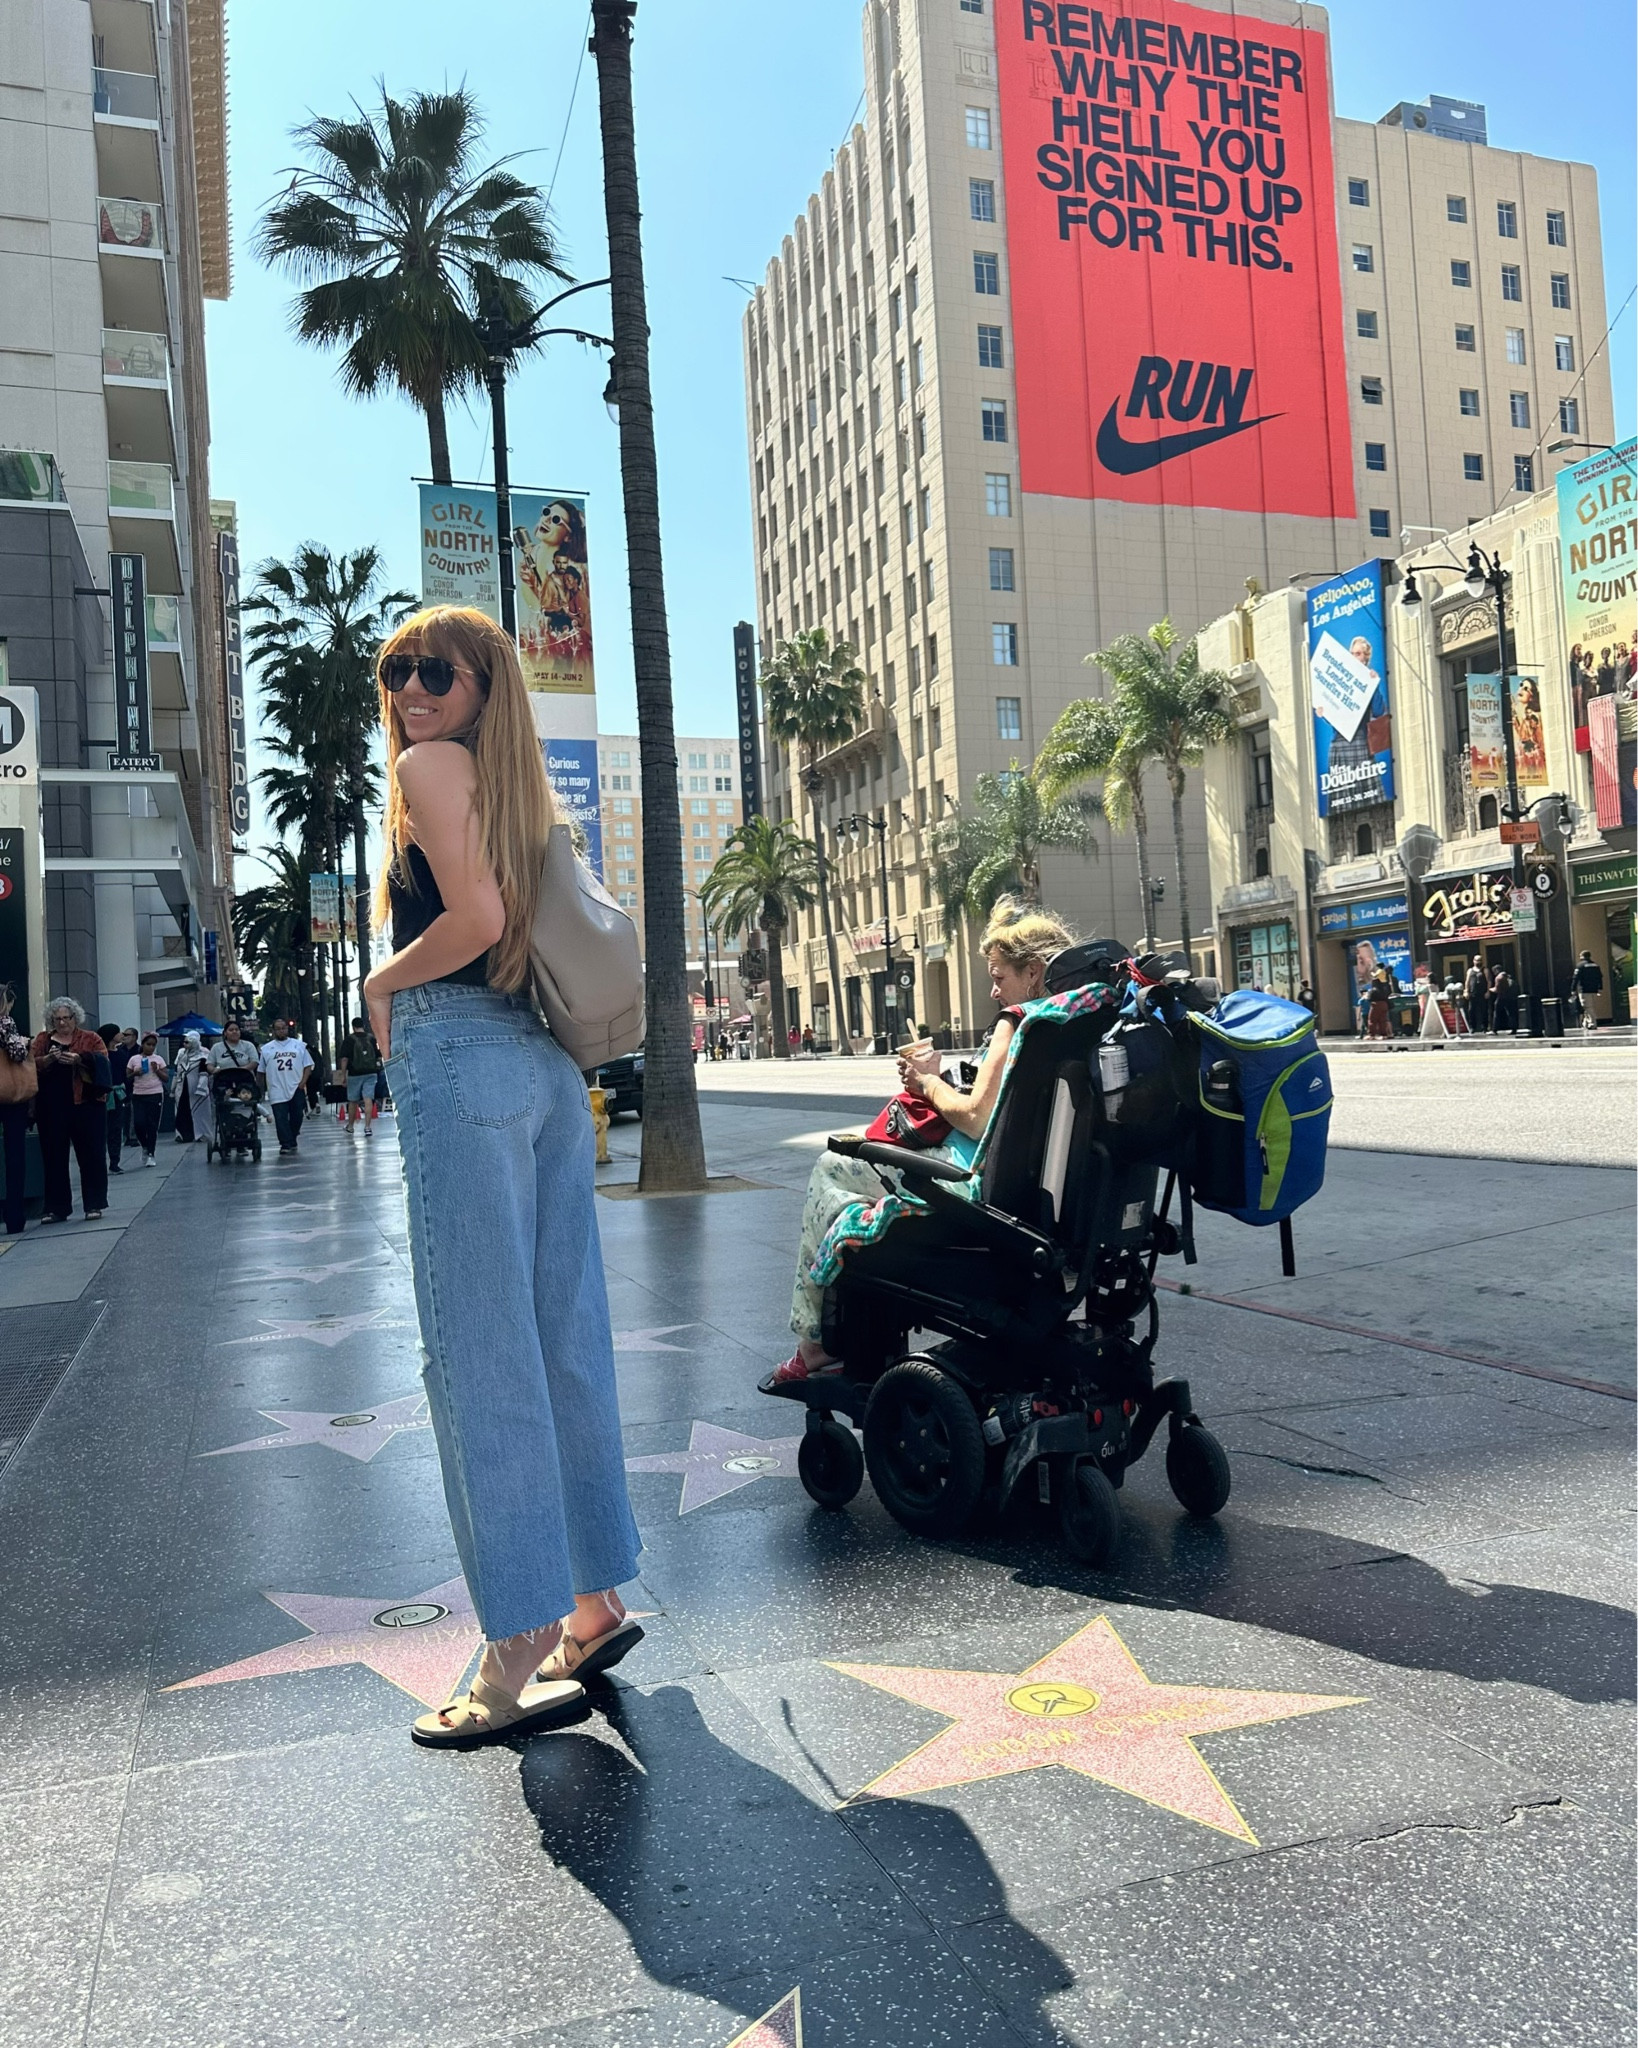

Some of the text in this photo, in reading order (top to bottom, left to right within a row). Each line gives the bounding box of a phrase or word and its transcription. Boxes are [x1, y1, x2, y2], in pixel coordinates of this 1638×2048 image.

[1022, 0, 1303, 93] REMEMBER
[1050, 49, 1281, 134] WHY THE
[1052, 97, 1286, 180] HELL YOU
[1036, 143, 1303, 226] SIGNED UP
[1057, 195, 1293, 273] FOR THIS.
[1125, 356, 1254, 425] RUN
[1572, 469, 1589, 481] THE
[1576, 467, 1610, 486] WINNING
[1575, 473, 1637, 526] GIR
[431, 502, 487, 530] GIRL
[1595, 506, 1633, 529] FROM THE
[424, 528, 494, 554] NORTH
[428, 552, 491, 576] COUNTRY
[433, 578, 455, 590] CONOR
[479, 583, 492, 594] BOB
[476, 591, 495, 602] DYLAN
[223, 550, 242, 676] TAFT
[1312, 589, 1376, 628] Los Angeles!
[1588, 614, 1609, 629] CONOR
[120, 556, 139, 754] DELPHINE
[1321, 648, 1368, 693] Broadway and
[1472, 682, 1497, 697] GIRL
[738, 647, 753, 765] HOLLYWOOD
[1469, 699, 1500, 711] NORTH
[113, 757, 156, 767] EATERY
[549, 756, 580, 770] Curious
[558, 778, 568, 787] so
[569, 777, 591, 790] many
[744, 772, 754, 783] &
[1320, 760, 1387, 791] Doubtfire
[573, 793, 587, 804] are
[1511, 825, 1524, 833] END
[1519, 832, 1537, 841] WORK
[1539, 876, 1548, 887] P
[1361, 909, 1375, 919] Los
[1423, 872, 1506, 937] Frolic
[276, 1058, 294, 1071] 24
[294, 1637, 402, 1661] CAREY
